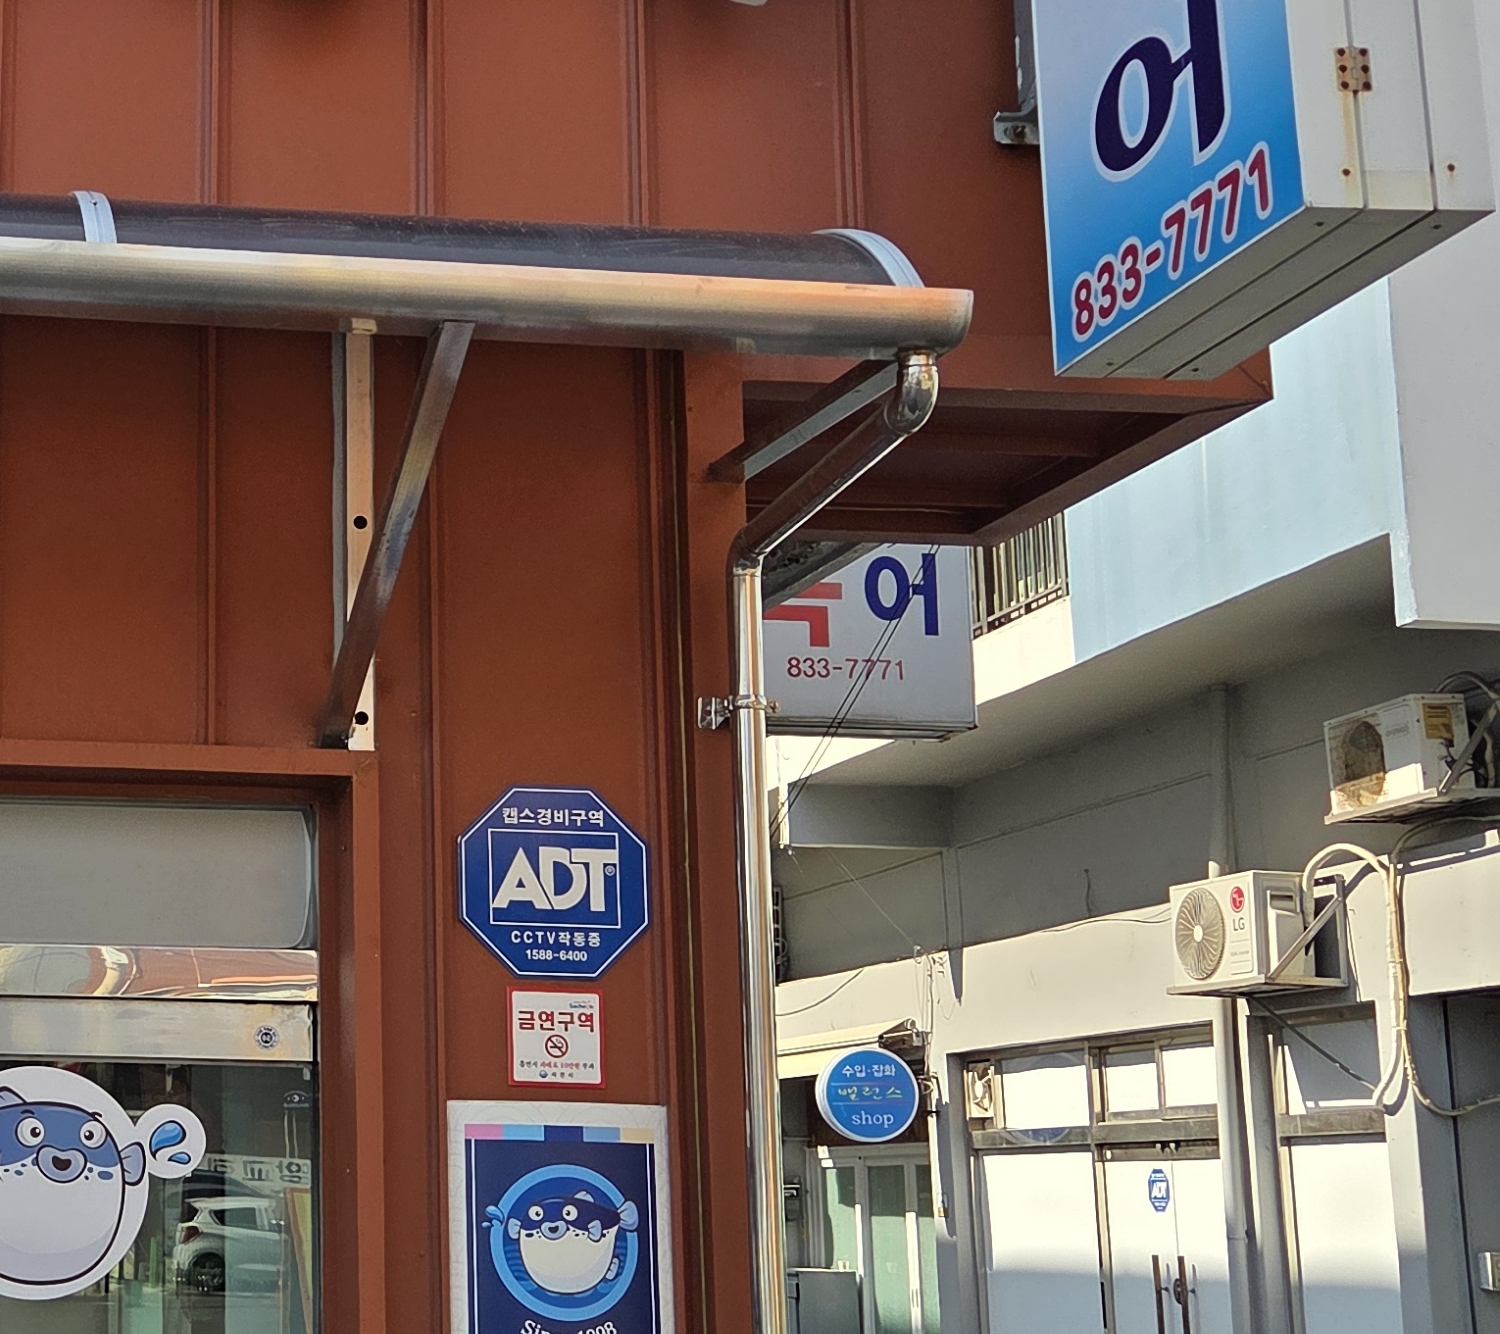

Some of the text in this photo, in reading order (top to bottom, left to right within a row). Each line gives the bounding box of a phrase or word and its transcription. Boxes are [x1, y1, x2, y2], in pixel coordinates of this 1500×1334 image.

[1072, 148, 1270, 336] 833-7771
[786, 656, 905, 680] 833-7771
[502, 807, 604, 827] 캡스경비구역
[492, 845, 618, 912] ADT
[1232, 917, 1246, 932] LG
[526, 949, 588, 962] 1588-6400
[518, 1010, 595, 1033] 금연구역
[851, 1110, 894, 1128] shop
